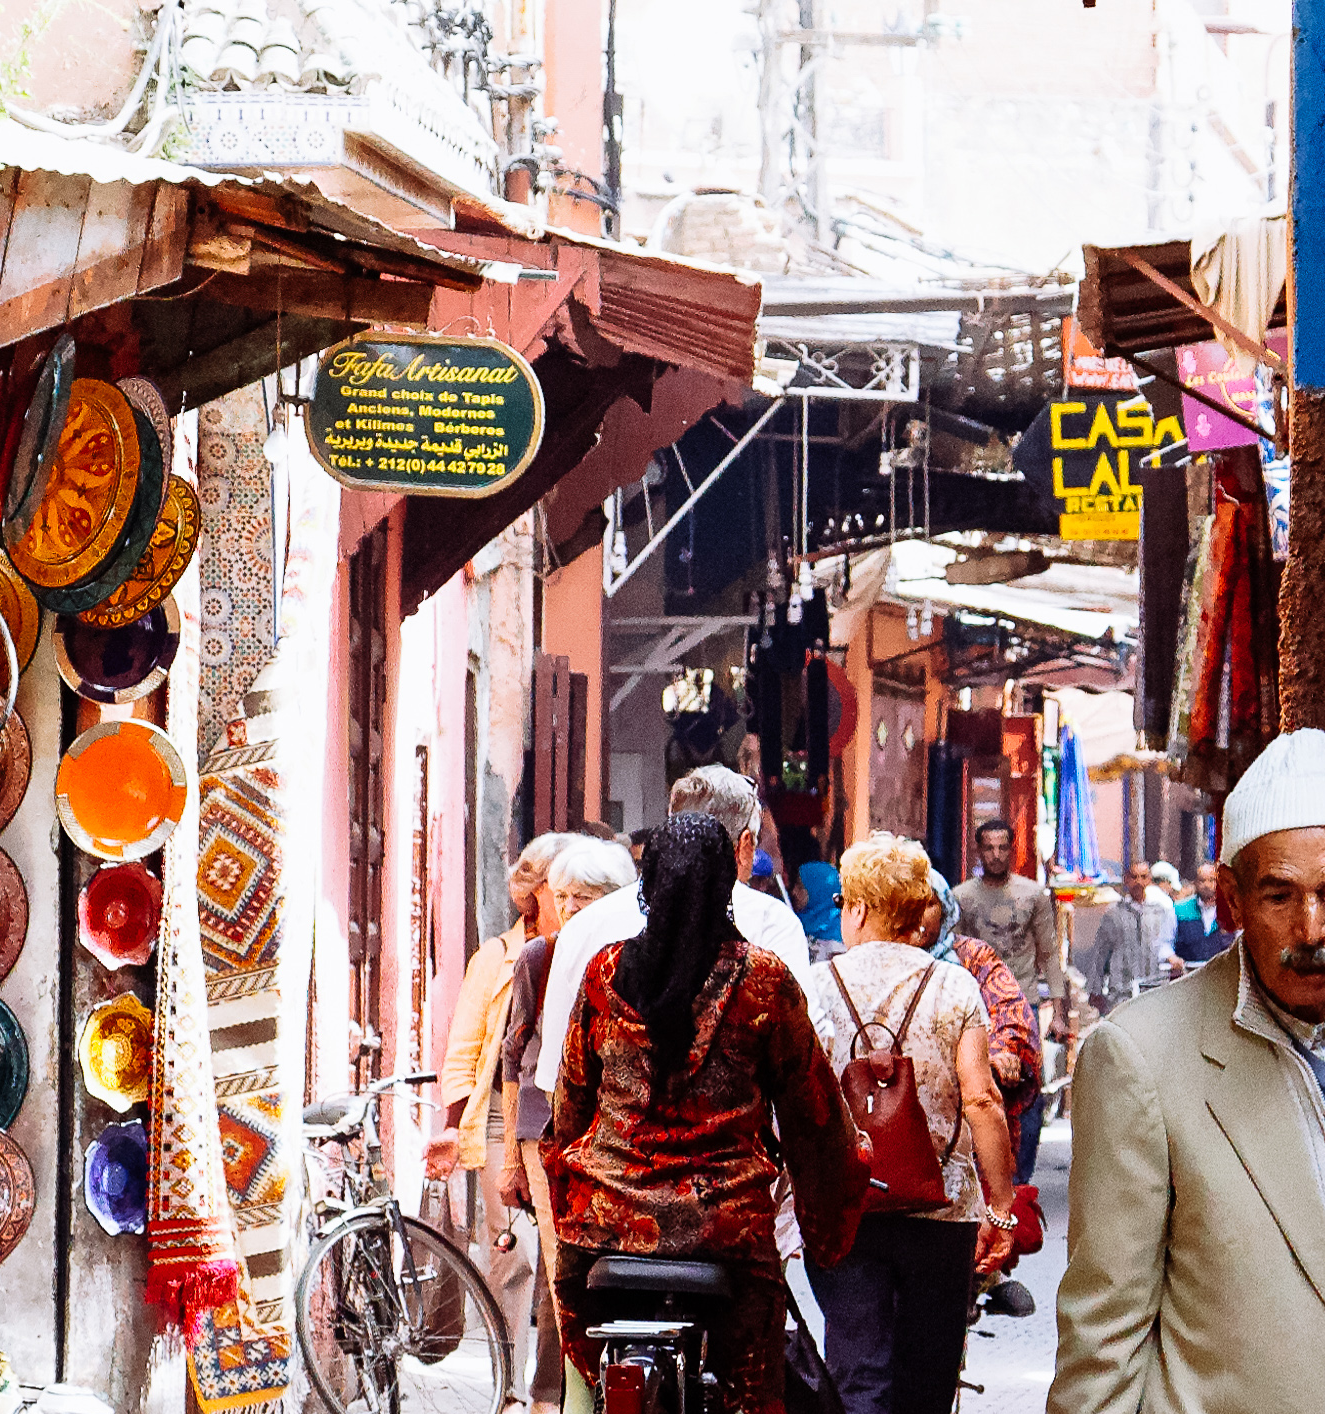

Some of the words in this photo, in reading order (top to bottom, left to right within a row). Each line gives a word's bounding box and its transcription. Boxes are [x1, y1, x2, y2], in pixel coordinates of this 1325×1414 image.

[328, 351, 395, 386] Fafa
[389, 353, 519, 384] Artisanat
[339, 385, 388, 400] Grand
[391, 388, 435, 402] choix
[437, 390, 459, 404] de
[461, 390, 506, 407] Tapis
[346, 402, 415, 418] Anciens,
[417, 405, 497, 421] Modernes
[334, 420, 352, 430] et
[1050, 400, 1186, 449] CASA
[463, 442, 509, 461] الزرابي
[1052, 449, 1163, 498] LAL
[1065, 496, 1142, 514] RESTA
